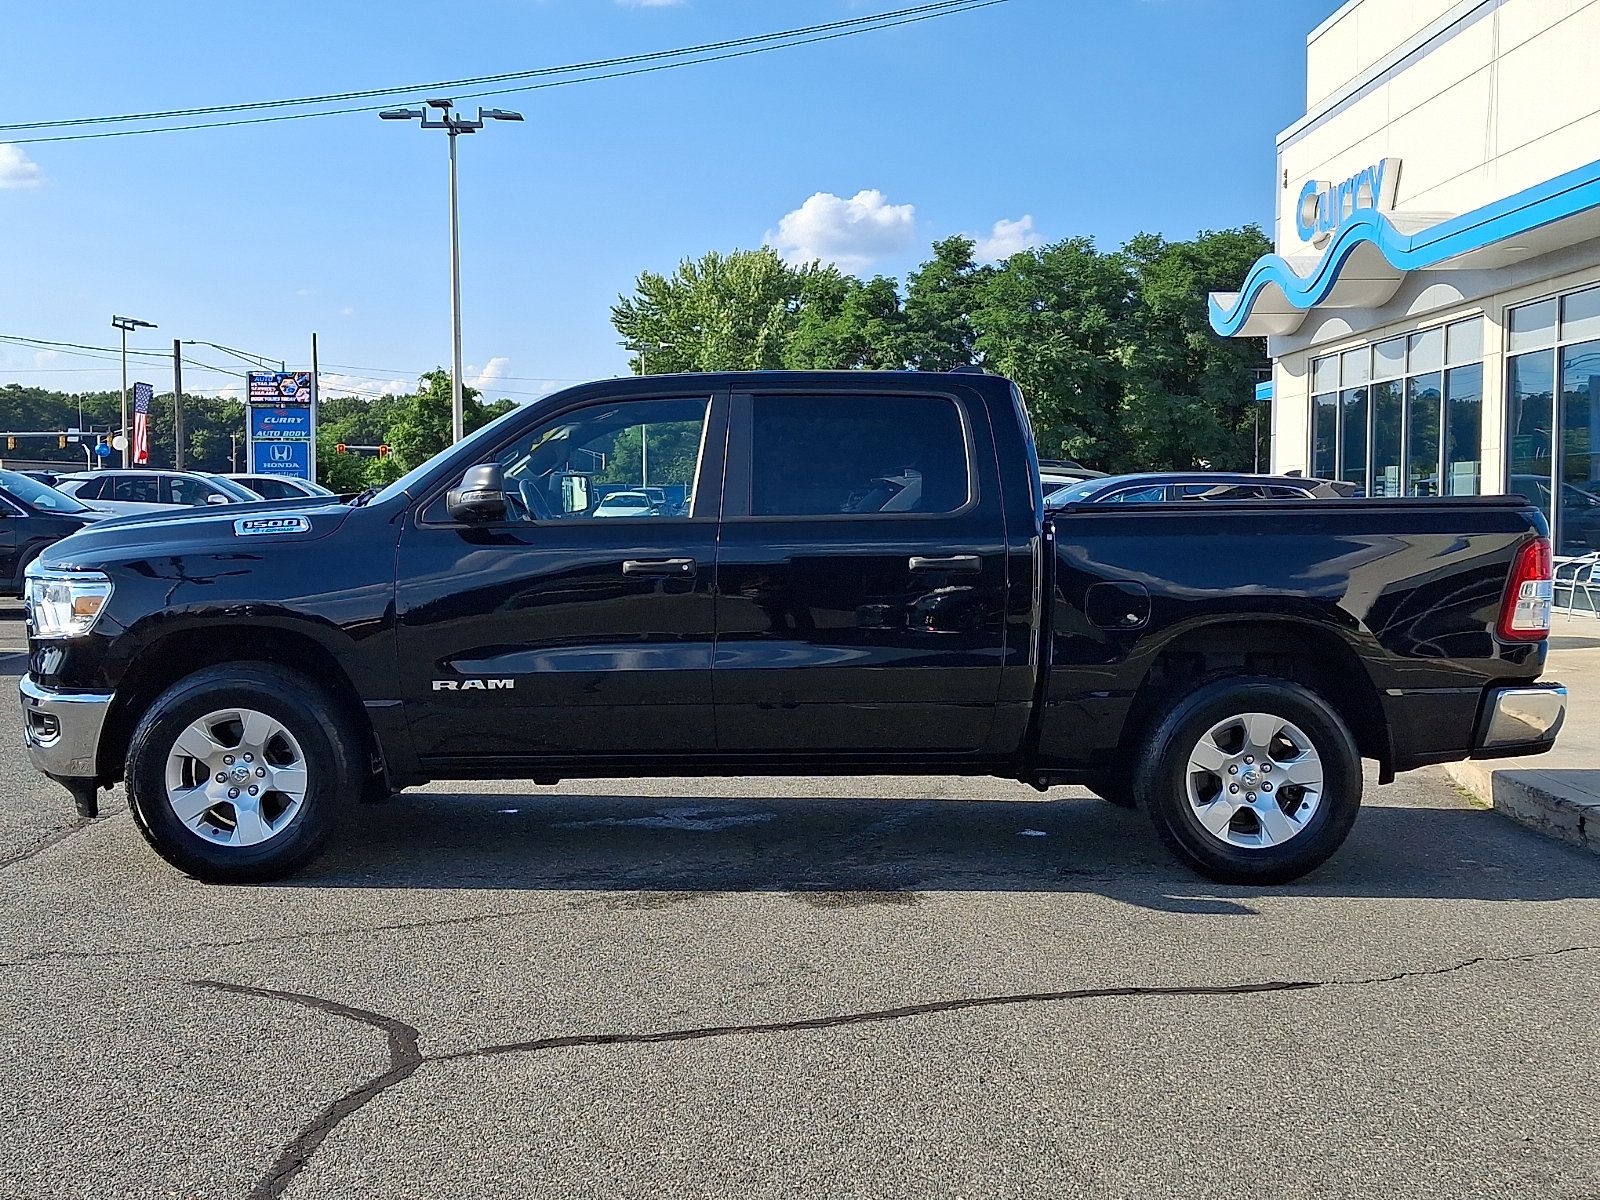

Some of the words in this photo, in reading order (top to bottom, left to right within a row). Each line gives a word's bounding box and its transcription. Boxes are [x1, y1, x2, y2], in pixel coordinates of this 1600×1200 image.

[1296, 157, 1400, 243] Curry
[263, 416, 305, 424] CURRY
[245, 519, 298, 528] 1500
[432, 679, 514, 691] RAM
